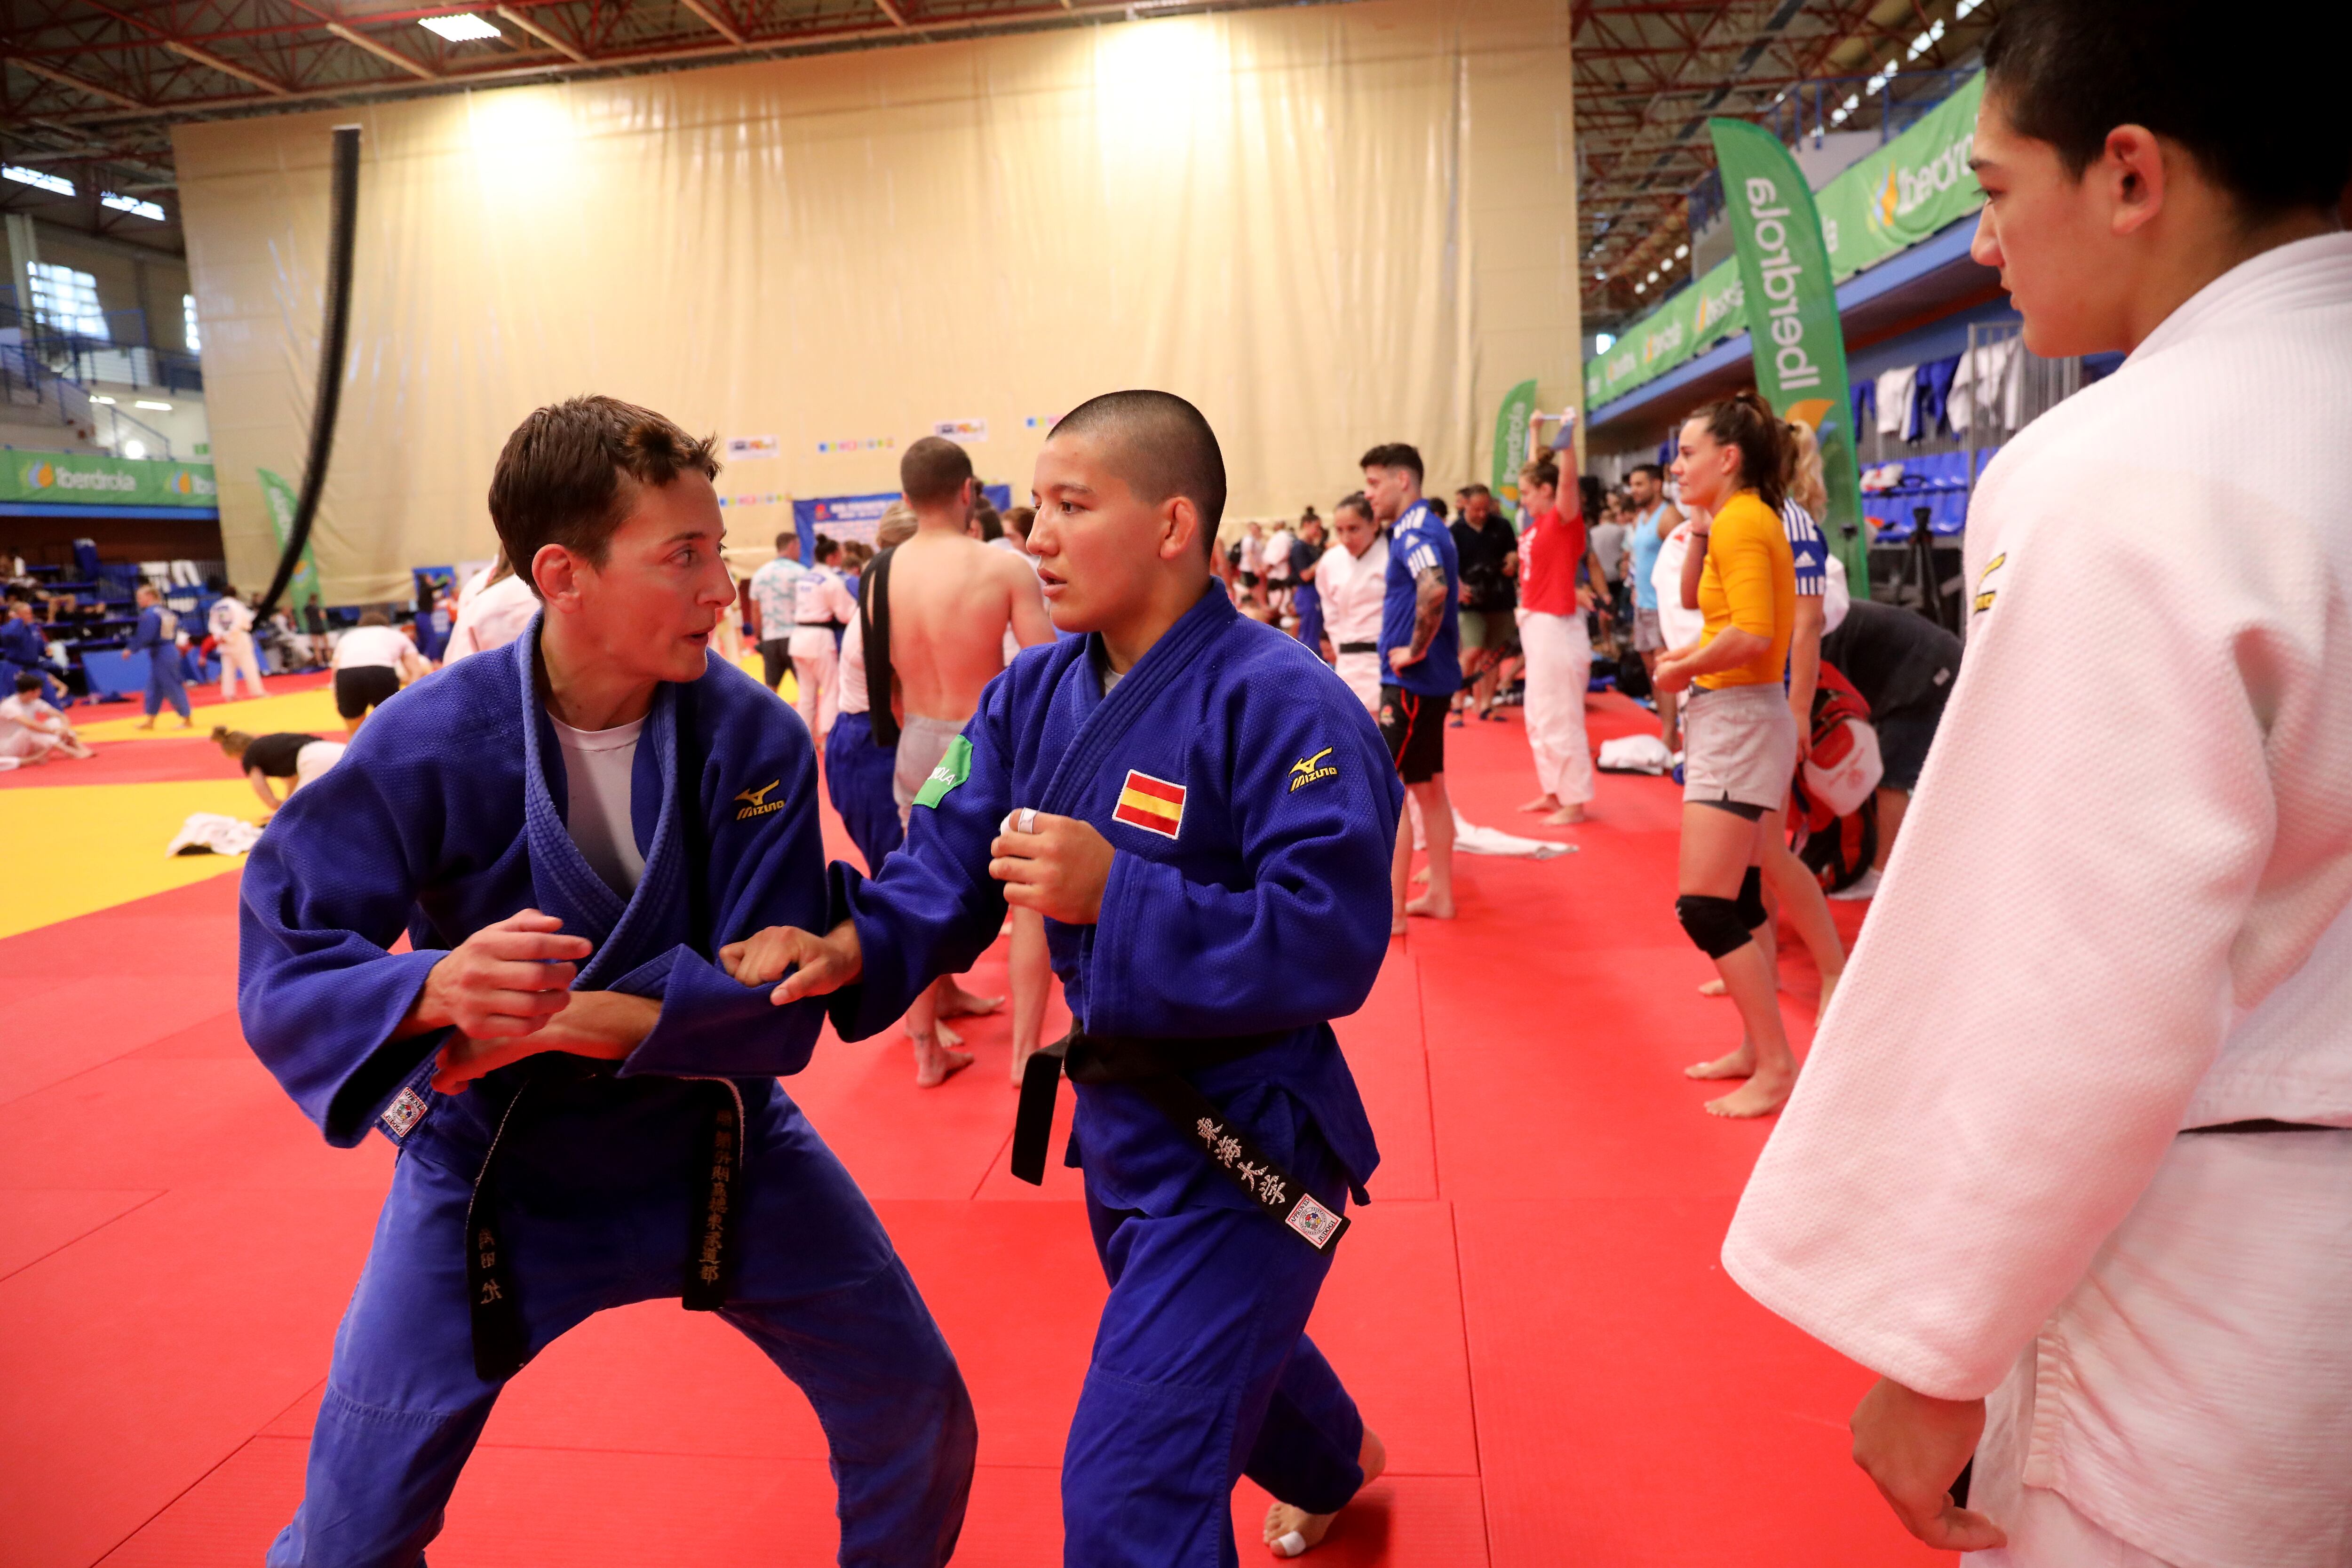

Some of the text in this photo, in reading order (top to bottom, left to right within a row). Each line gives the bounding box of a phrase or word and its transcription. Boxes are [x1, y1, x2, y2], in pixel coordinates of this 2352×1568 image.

[386, 1115, 403, 1132] JUDOGI
[1197, 1117, 1286, 1204] 東海大学
[1291, 1198, 1310, 1223] APPROVED
[1318, 1220, 1336, 1242] JUDOGI
